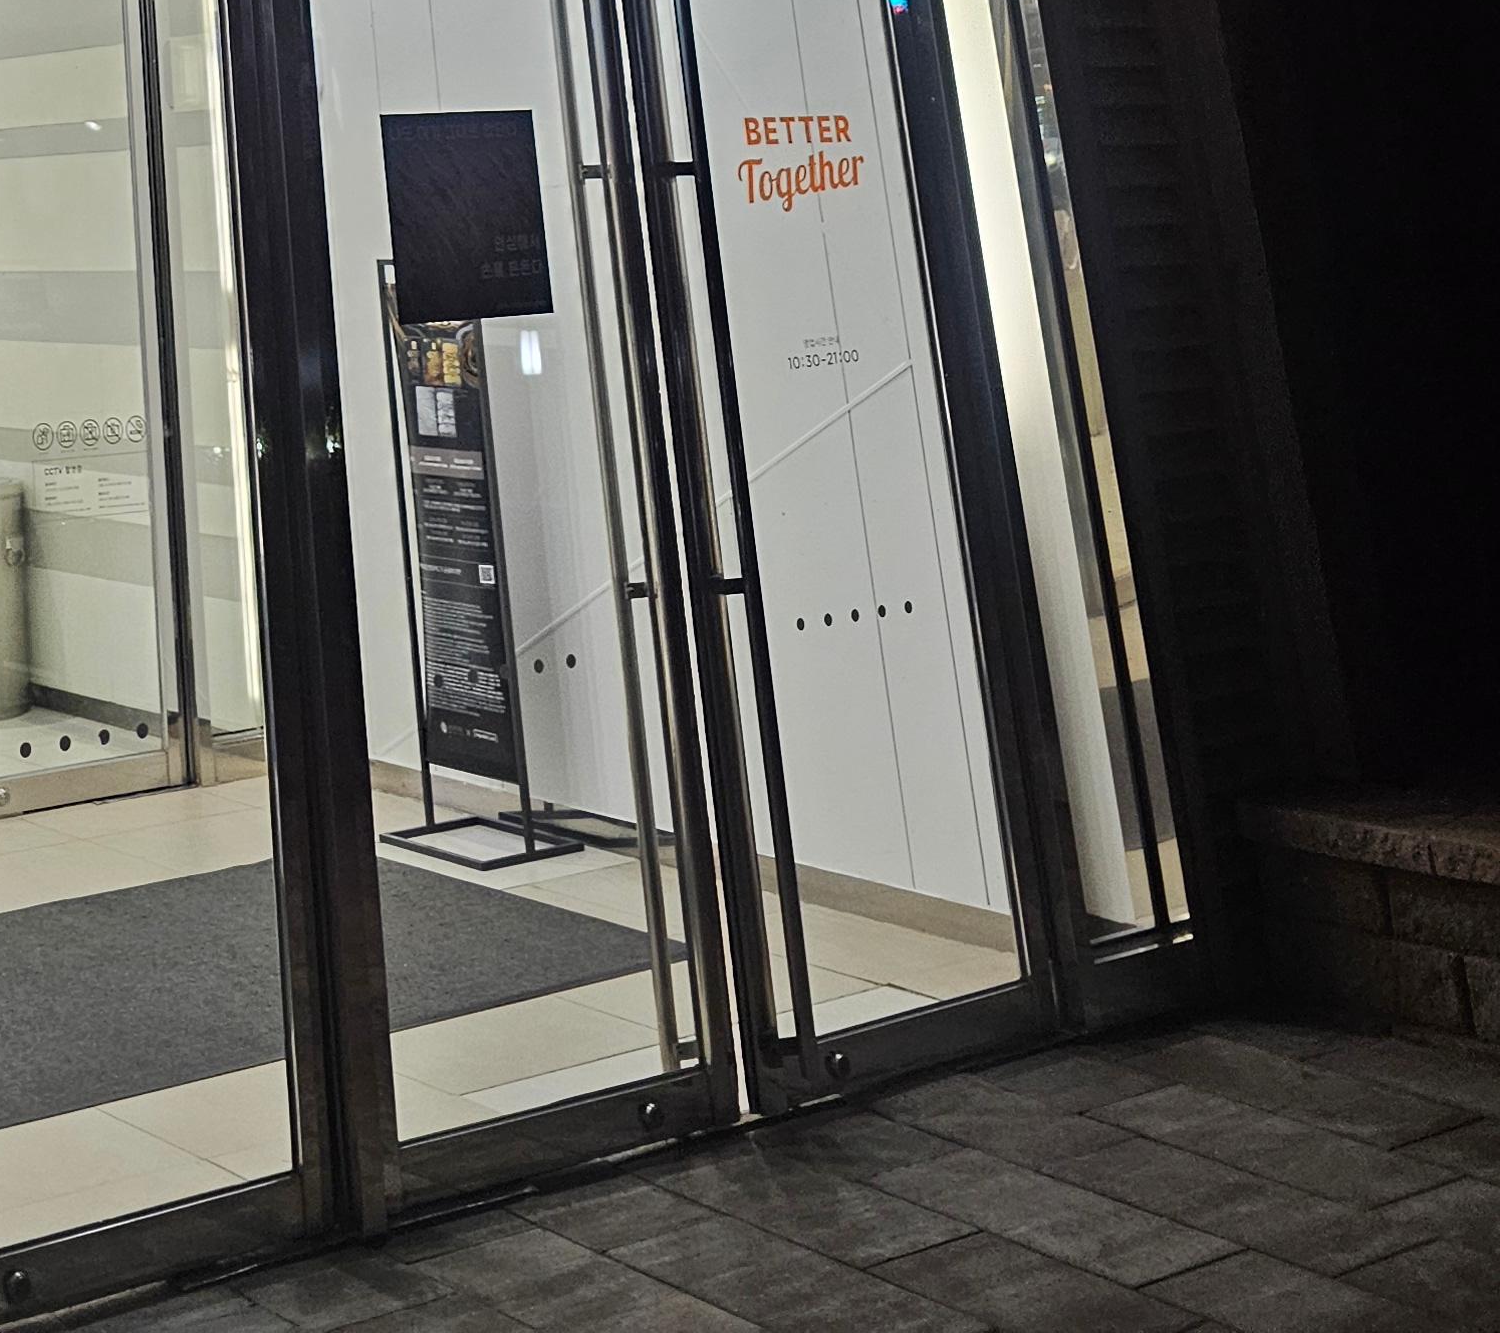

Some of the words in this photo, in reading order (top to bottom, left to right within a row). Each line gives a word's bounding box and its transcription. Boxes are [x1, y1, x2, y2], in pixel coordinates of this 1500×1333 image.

[743, 114, 852, 145] BETTER
[737, 150, 865, 212] Together
[787, 349, 859, 370] 10:30-21:00
